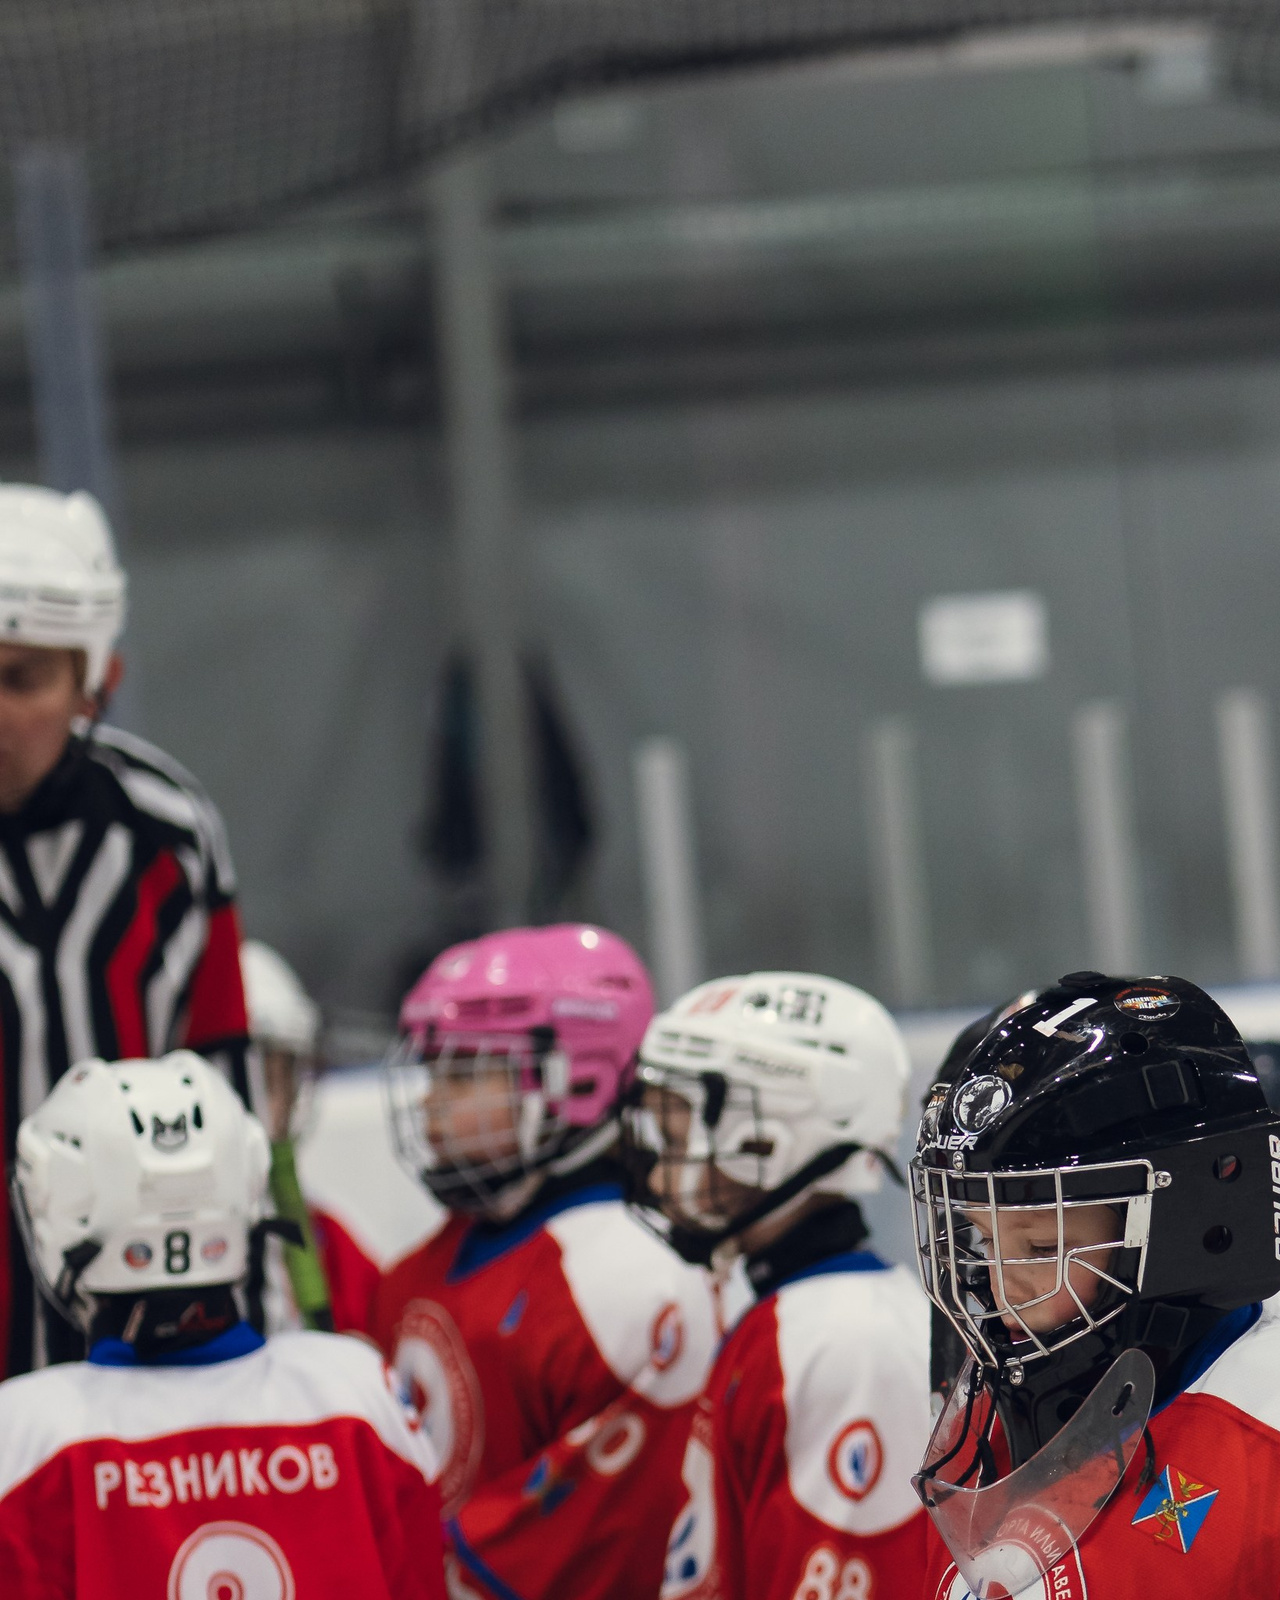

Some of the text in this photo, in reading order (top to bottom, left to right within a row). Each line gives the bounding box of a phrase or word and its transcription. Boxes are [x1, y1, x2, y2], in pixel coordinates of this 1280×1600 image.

[935, 1134, 979, 1151] UER
[164, 1229, 191, 1275] 8
[94, 1442, 340, 1510] РЕЗНИКОВ
